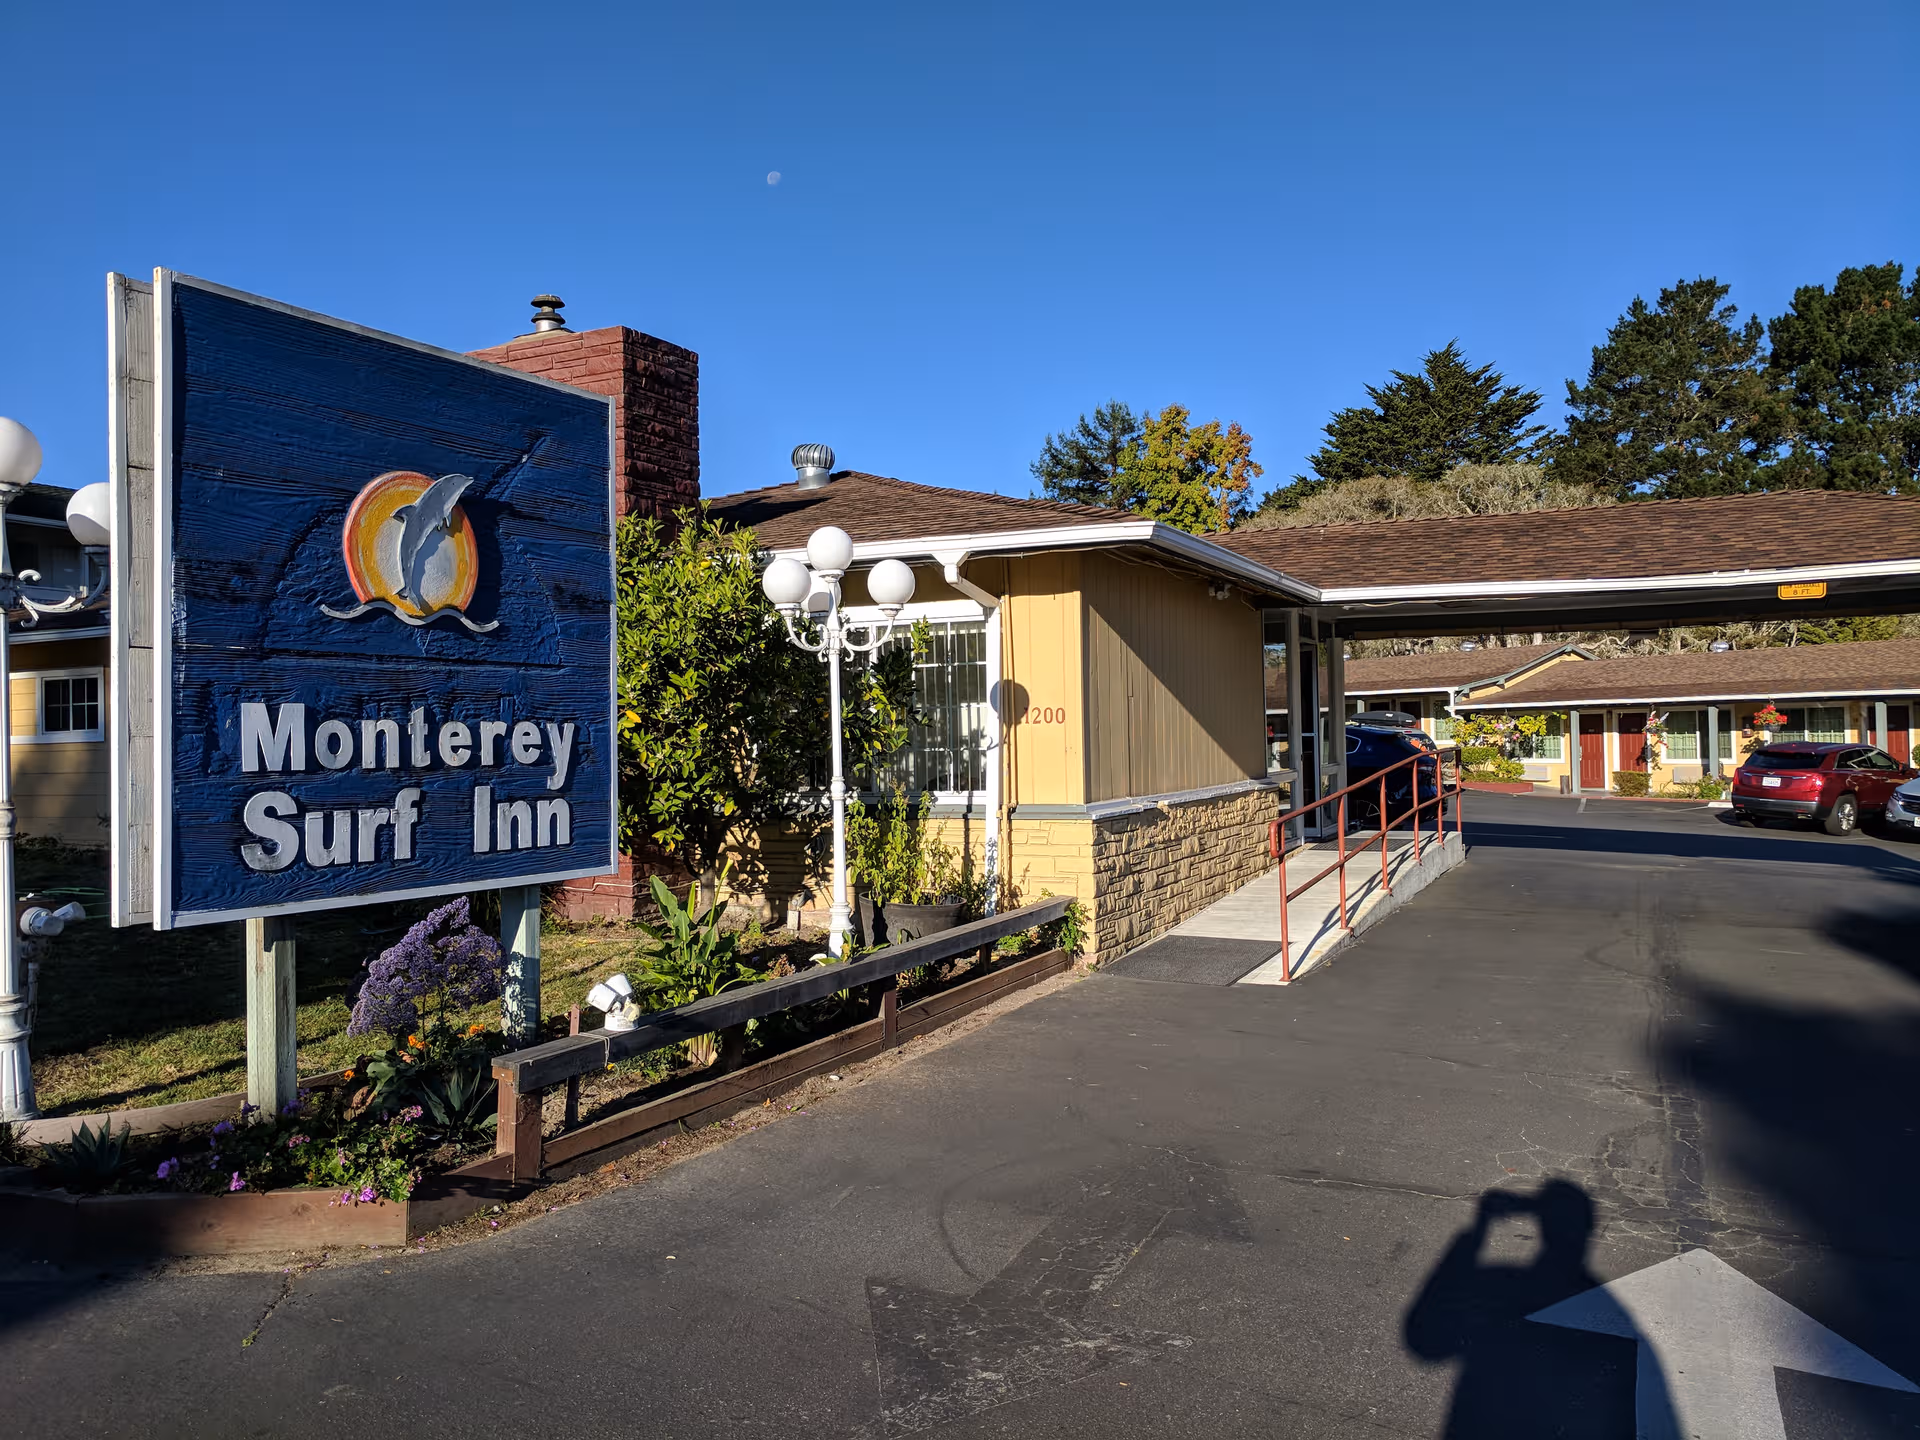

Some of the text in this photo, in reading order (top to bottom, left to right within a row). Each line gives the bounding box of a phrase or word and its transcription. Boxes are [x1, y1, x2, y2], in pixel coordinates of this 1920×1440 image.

[241, 702, 575, 790] Monterey
[1024, 706, 1066, 724] 1200
[241, 785, 571, 871] Surf Inn
